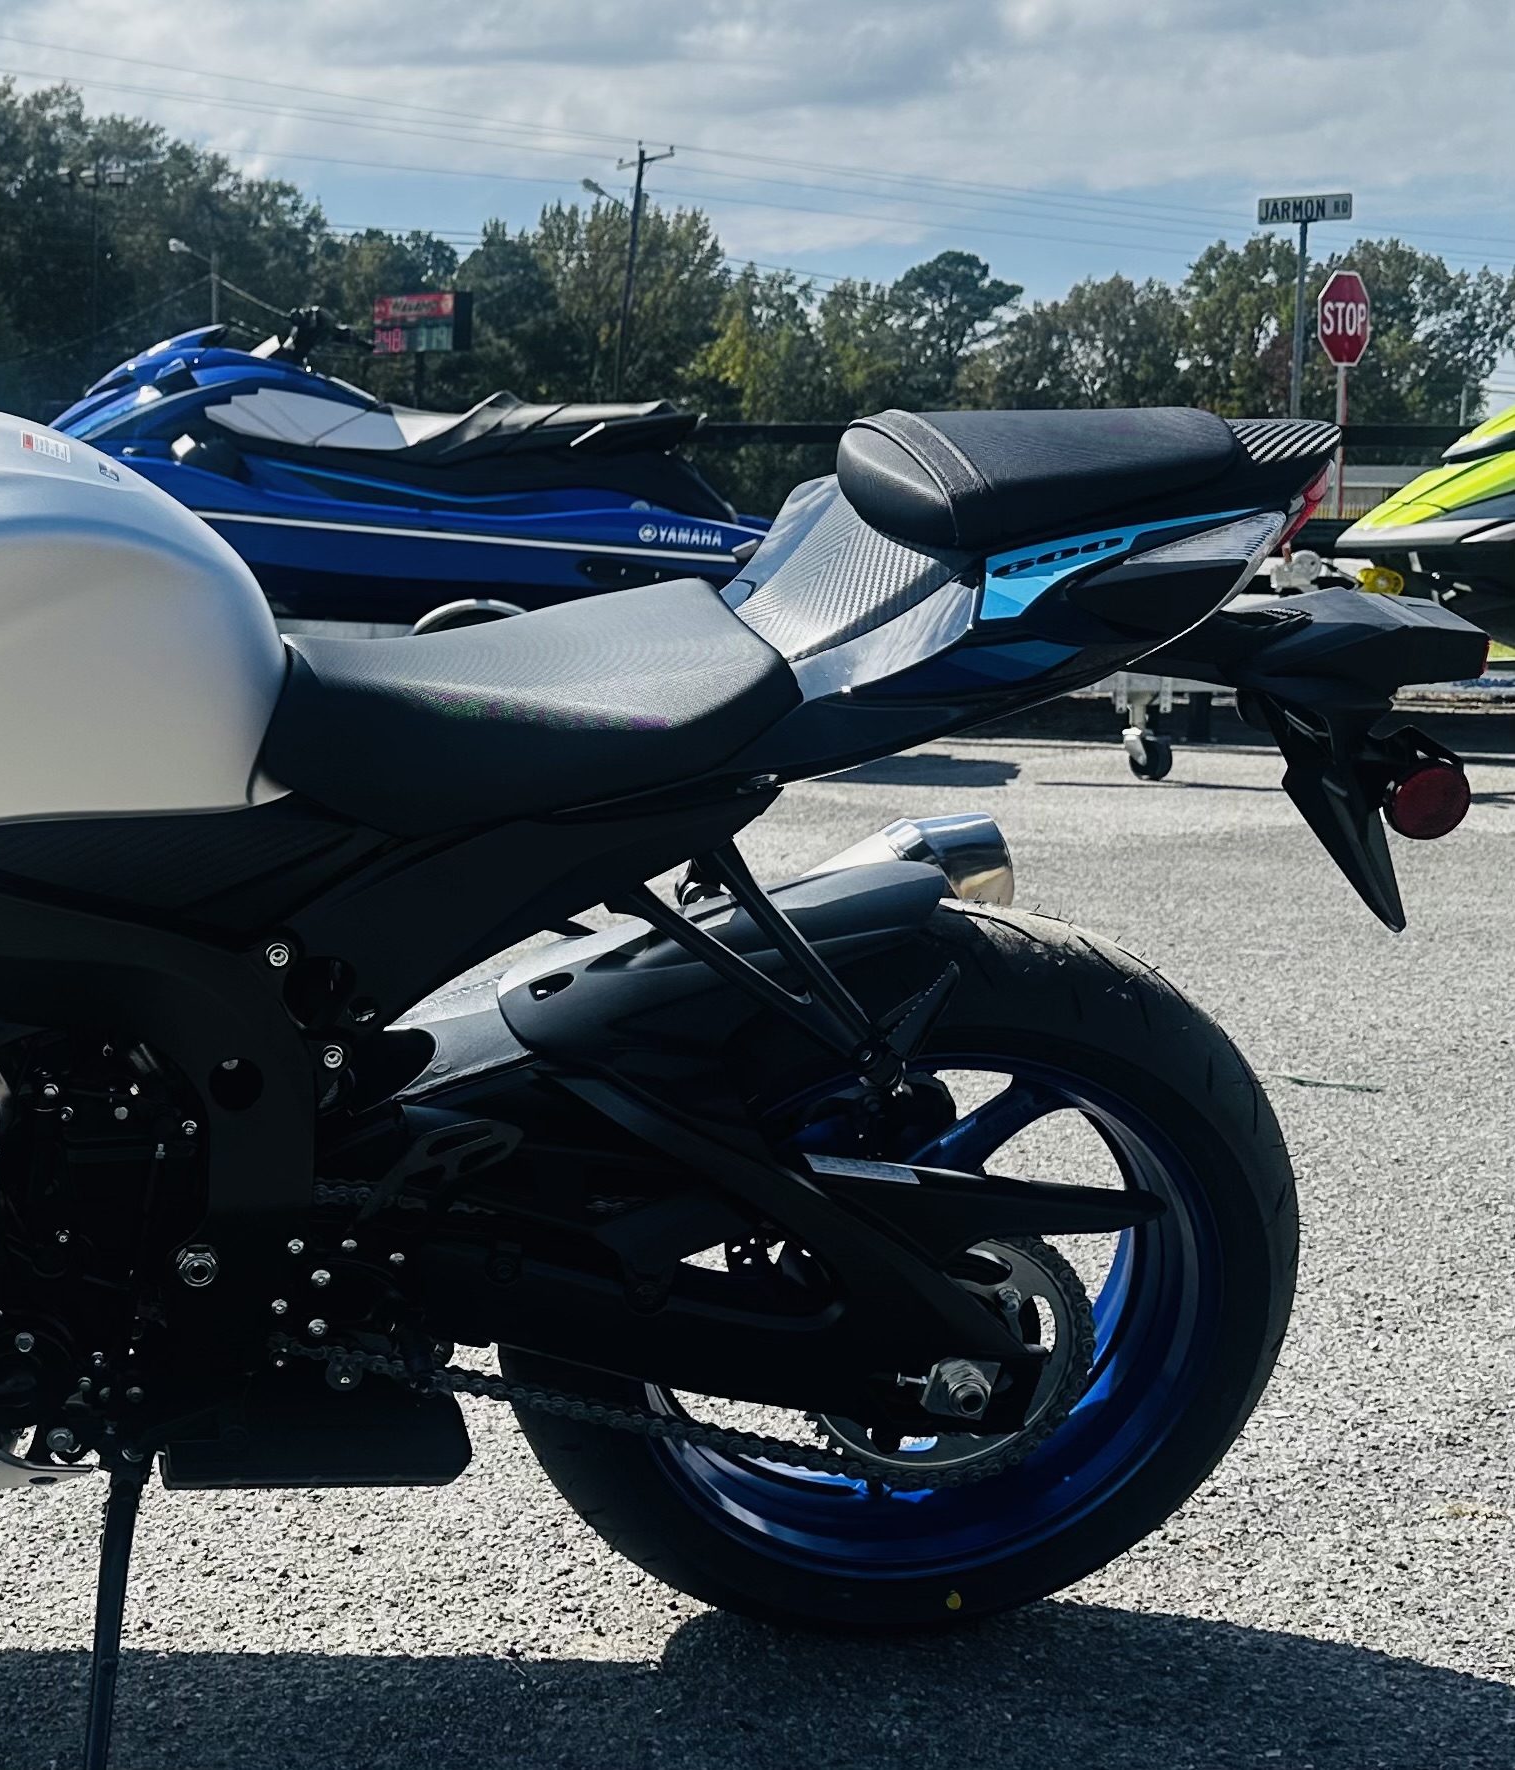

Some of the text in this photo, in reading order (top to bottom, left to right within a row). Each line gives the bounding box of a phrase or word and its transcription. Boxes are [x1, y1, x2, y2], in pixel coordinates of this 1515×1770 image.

[1260, 199, 1349, 222] JARMON RD
[1322, 301, 1367, 337] STOP
[659, 525, 722, 547] YAMAHA
[991, 537, 1124, 579] 600
